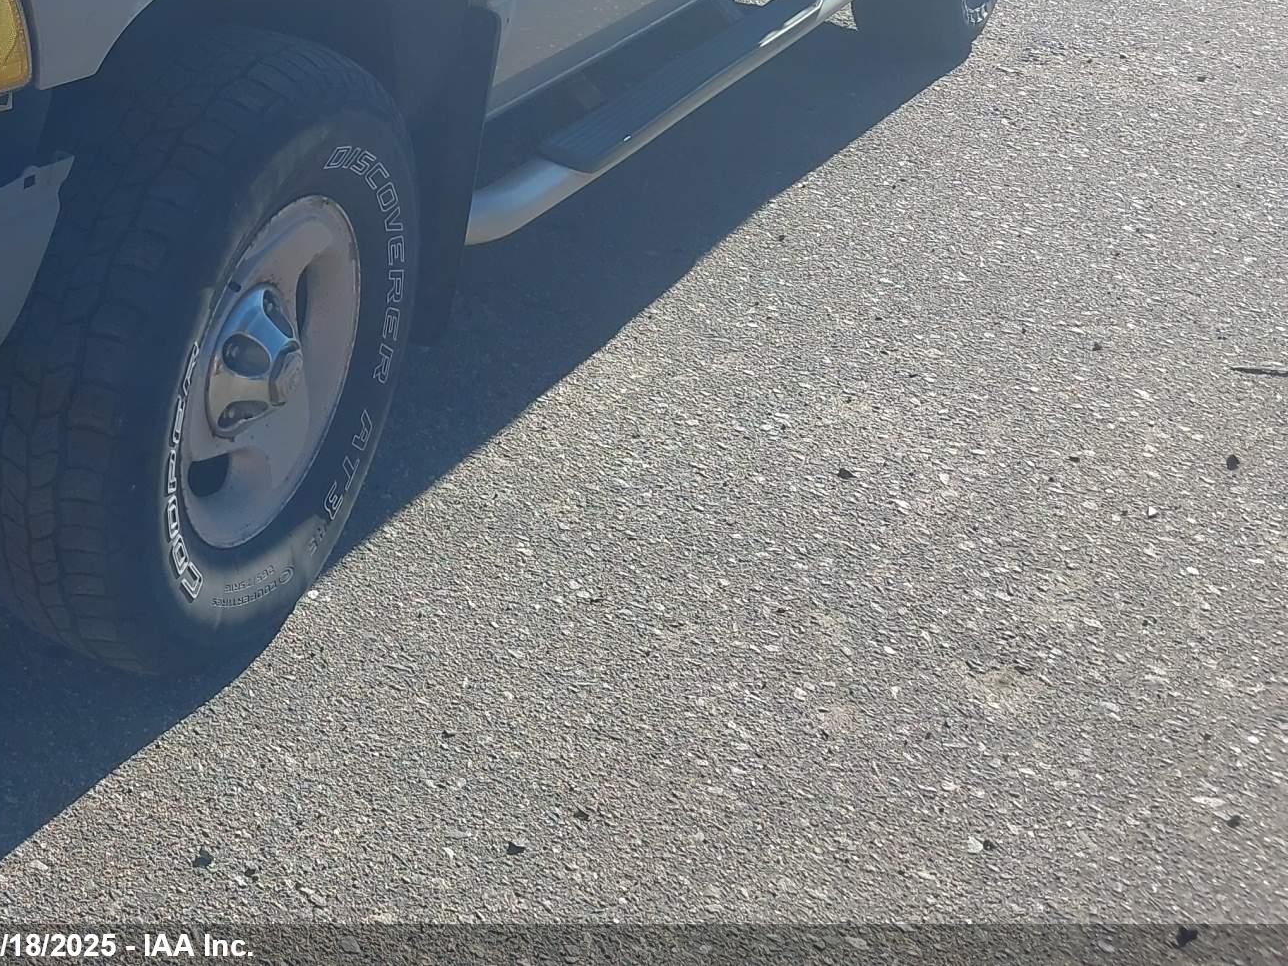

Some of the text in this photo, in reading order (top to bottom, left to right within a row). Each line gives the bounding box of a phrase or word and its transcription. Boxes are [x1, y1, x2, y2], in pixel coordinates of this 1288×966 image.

[167, 340, 203, 600] COOPER
[323, 144, 405, 521] DISCOVERER AT3
